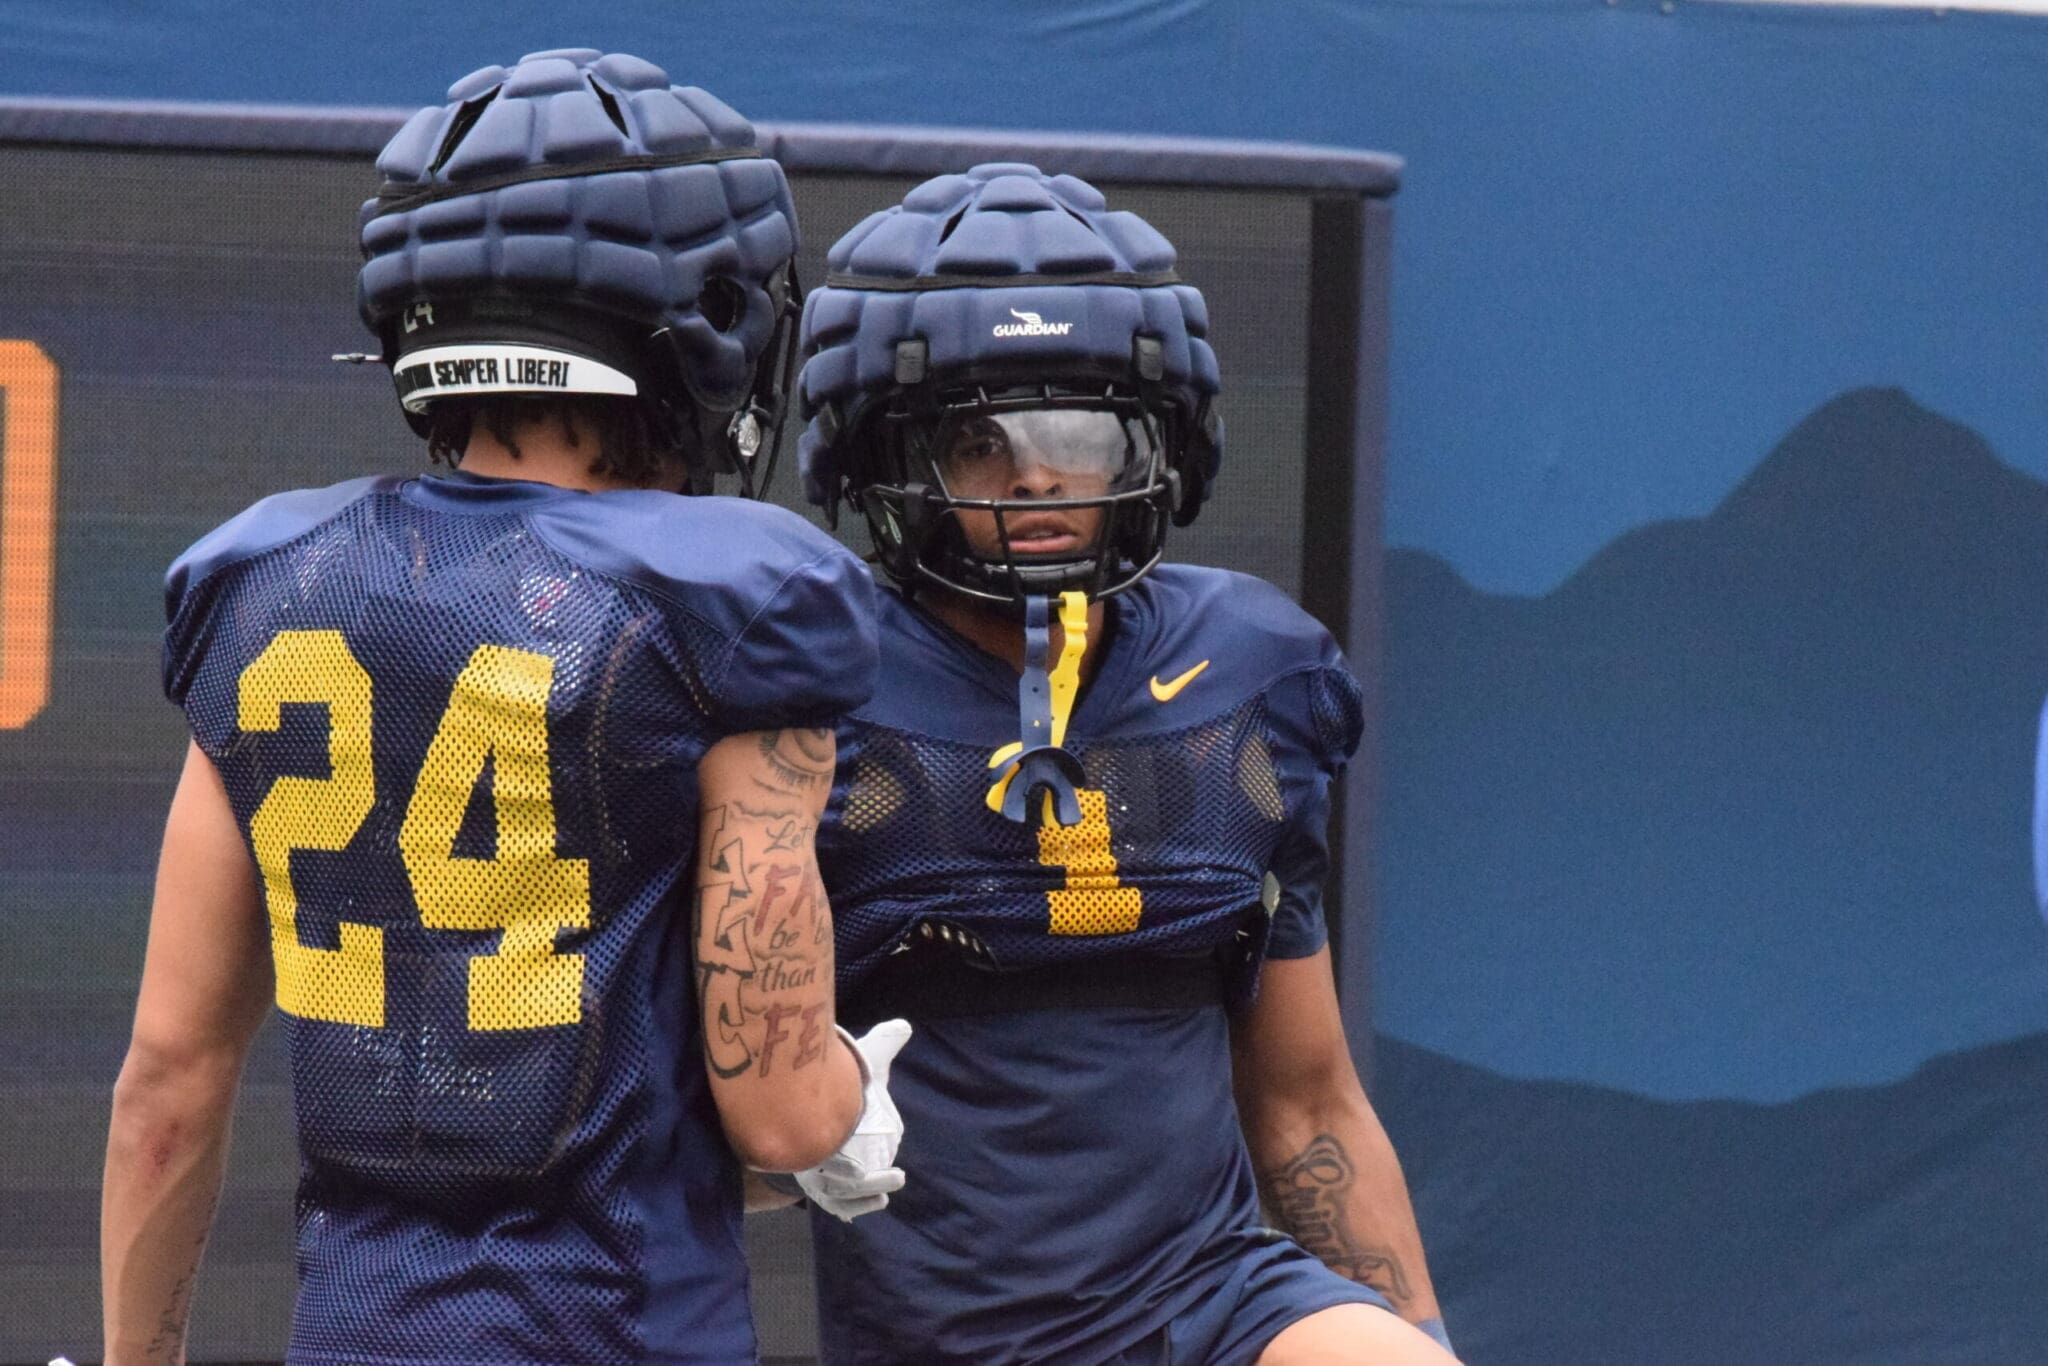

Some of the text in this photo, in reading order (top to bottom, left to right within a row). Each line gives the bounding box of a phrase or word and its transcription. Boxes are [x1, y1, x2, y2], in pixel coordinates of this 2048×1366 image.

[993, 323, 1069, 337] GUARDIAN
[434, 358, 499, 387] SEMPER
[505, 358, 570, 387] LIBERI
[238, 630, 591, 1031] 24
[1036, 786, 1142, 936] 1
[769, 918, 800, 949] be
[760, 961, 816, 992] than
